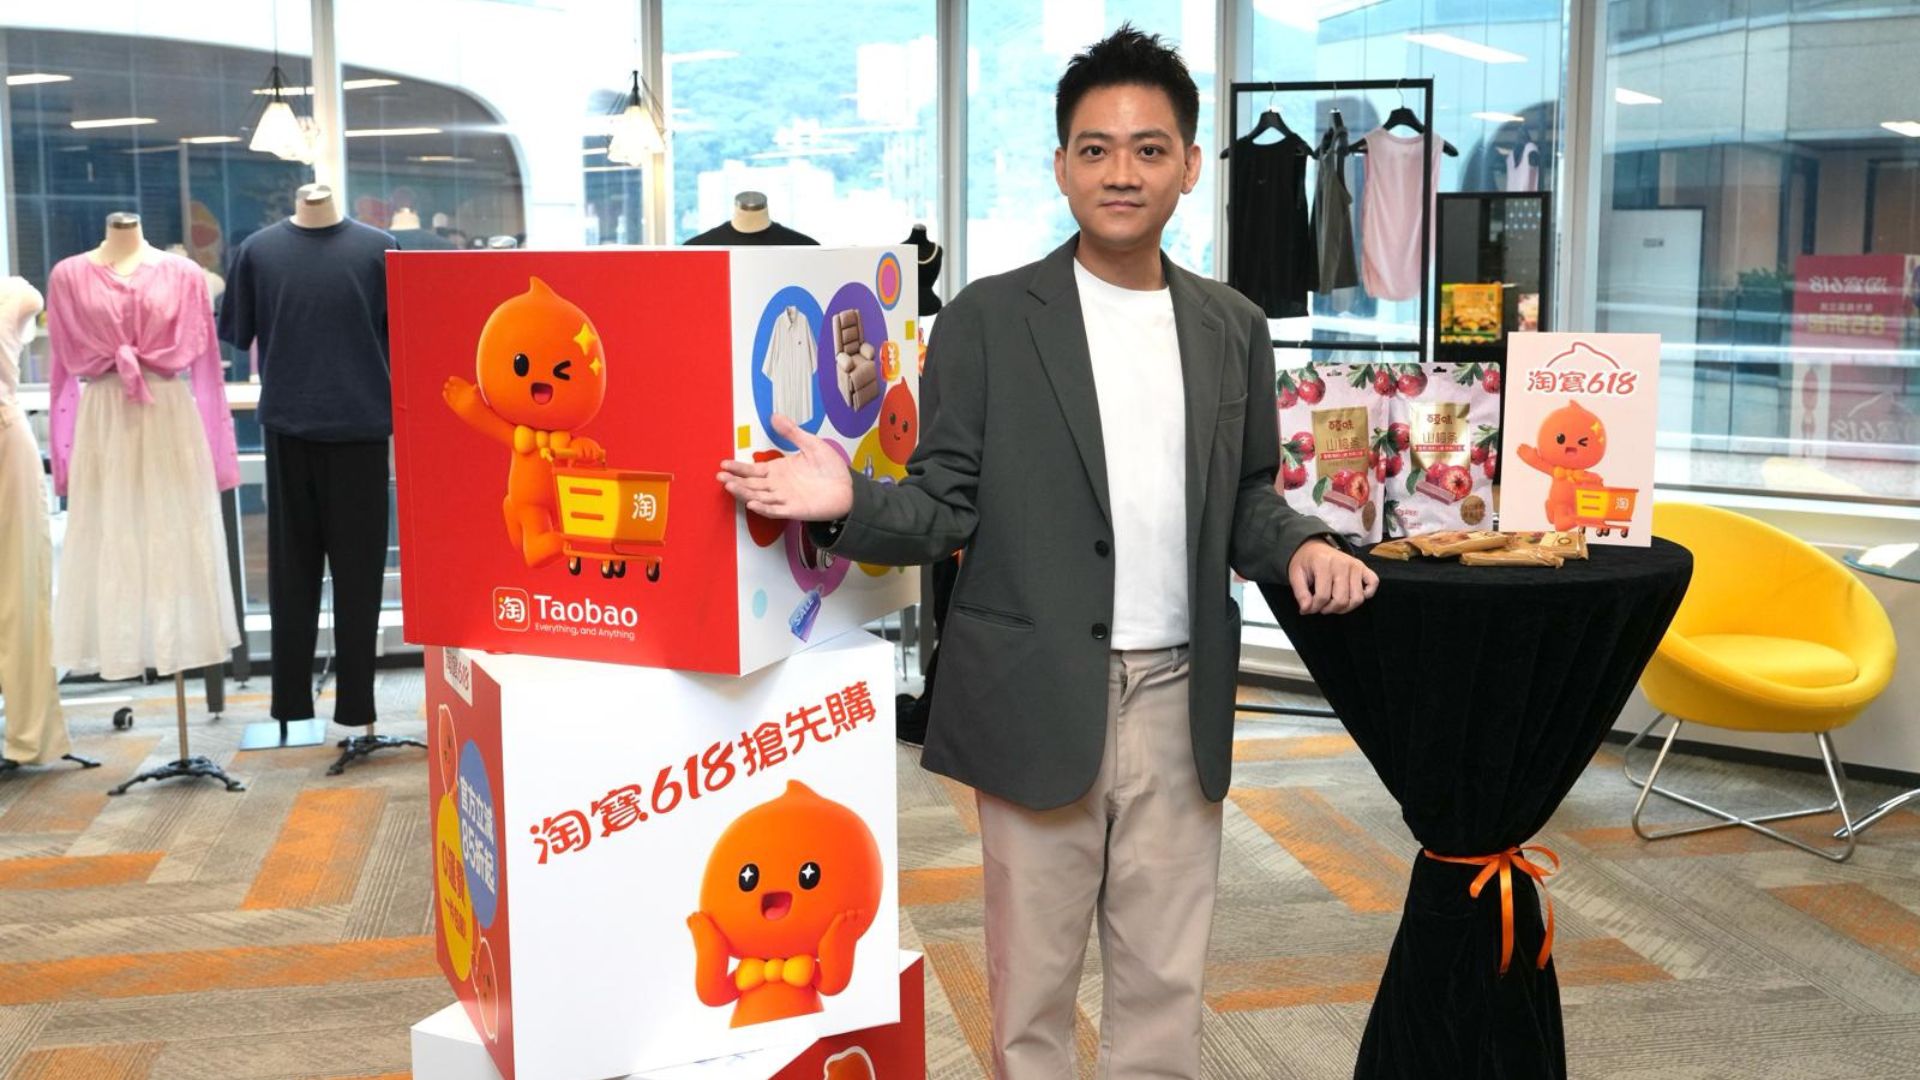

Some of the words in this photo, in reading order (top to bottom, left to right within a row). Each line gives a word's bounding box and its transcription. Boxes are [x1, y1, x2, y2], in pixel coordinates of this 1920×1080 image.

[1527, 371, 1637, 394] 淘寶618
[632, 493, 656, 521] 淘
[498, 596, 525, 623] 淘
[533, 595, 638, 627] Taobao
[535, 623, 578, 636] Everything,
[581, 627, 596, 636] and
[599, 629, 635, 641] Anything
[529, 681, 877, 864] 淘寶618搶先購
